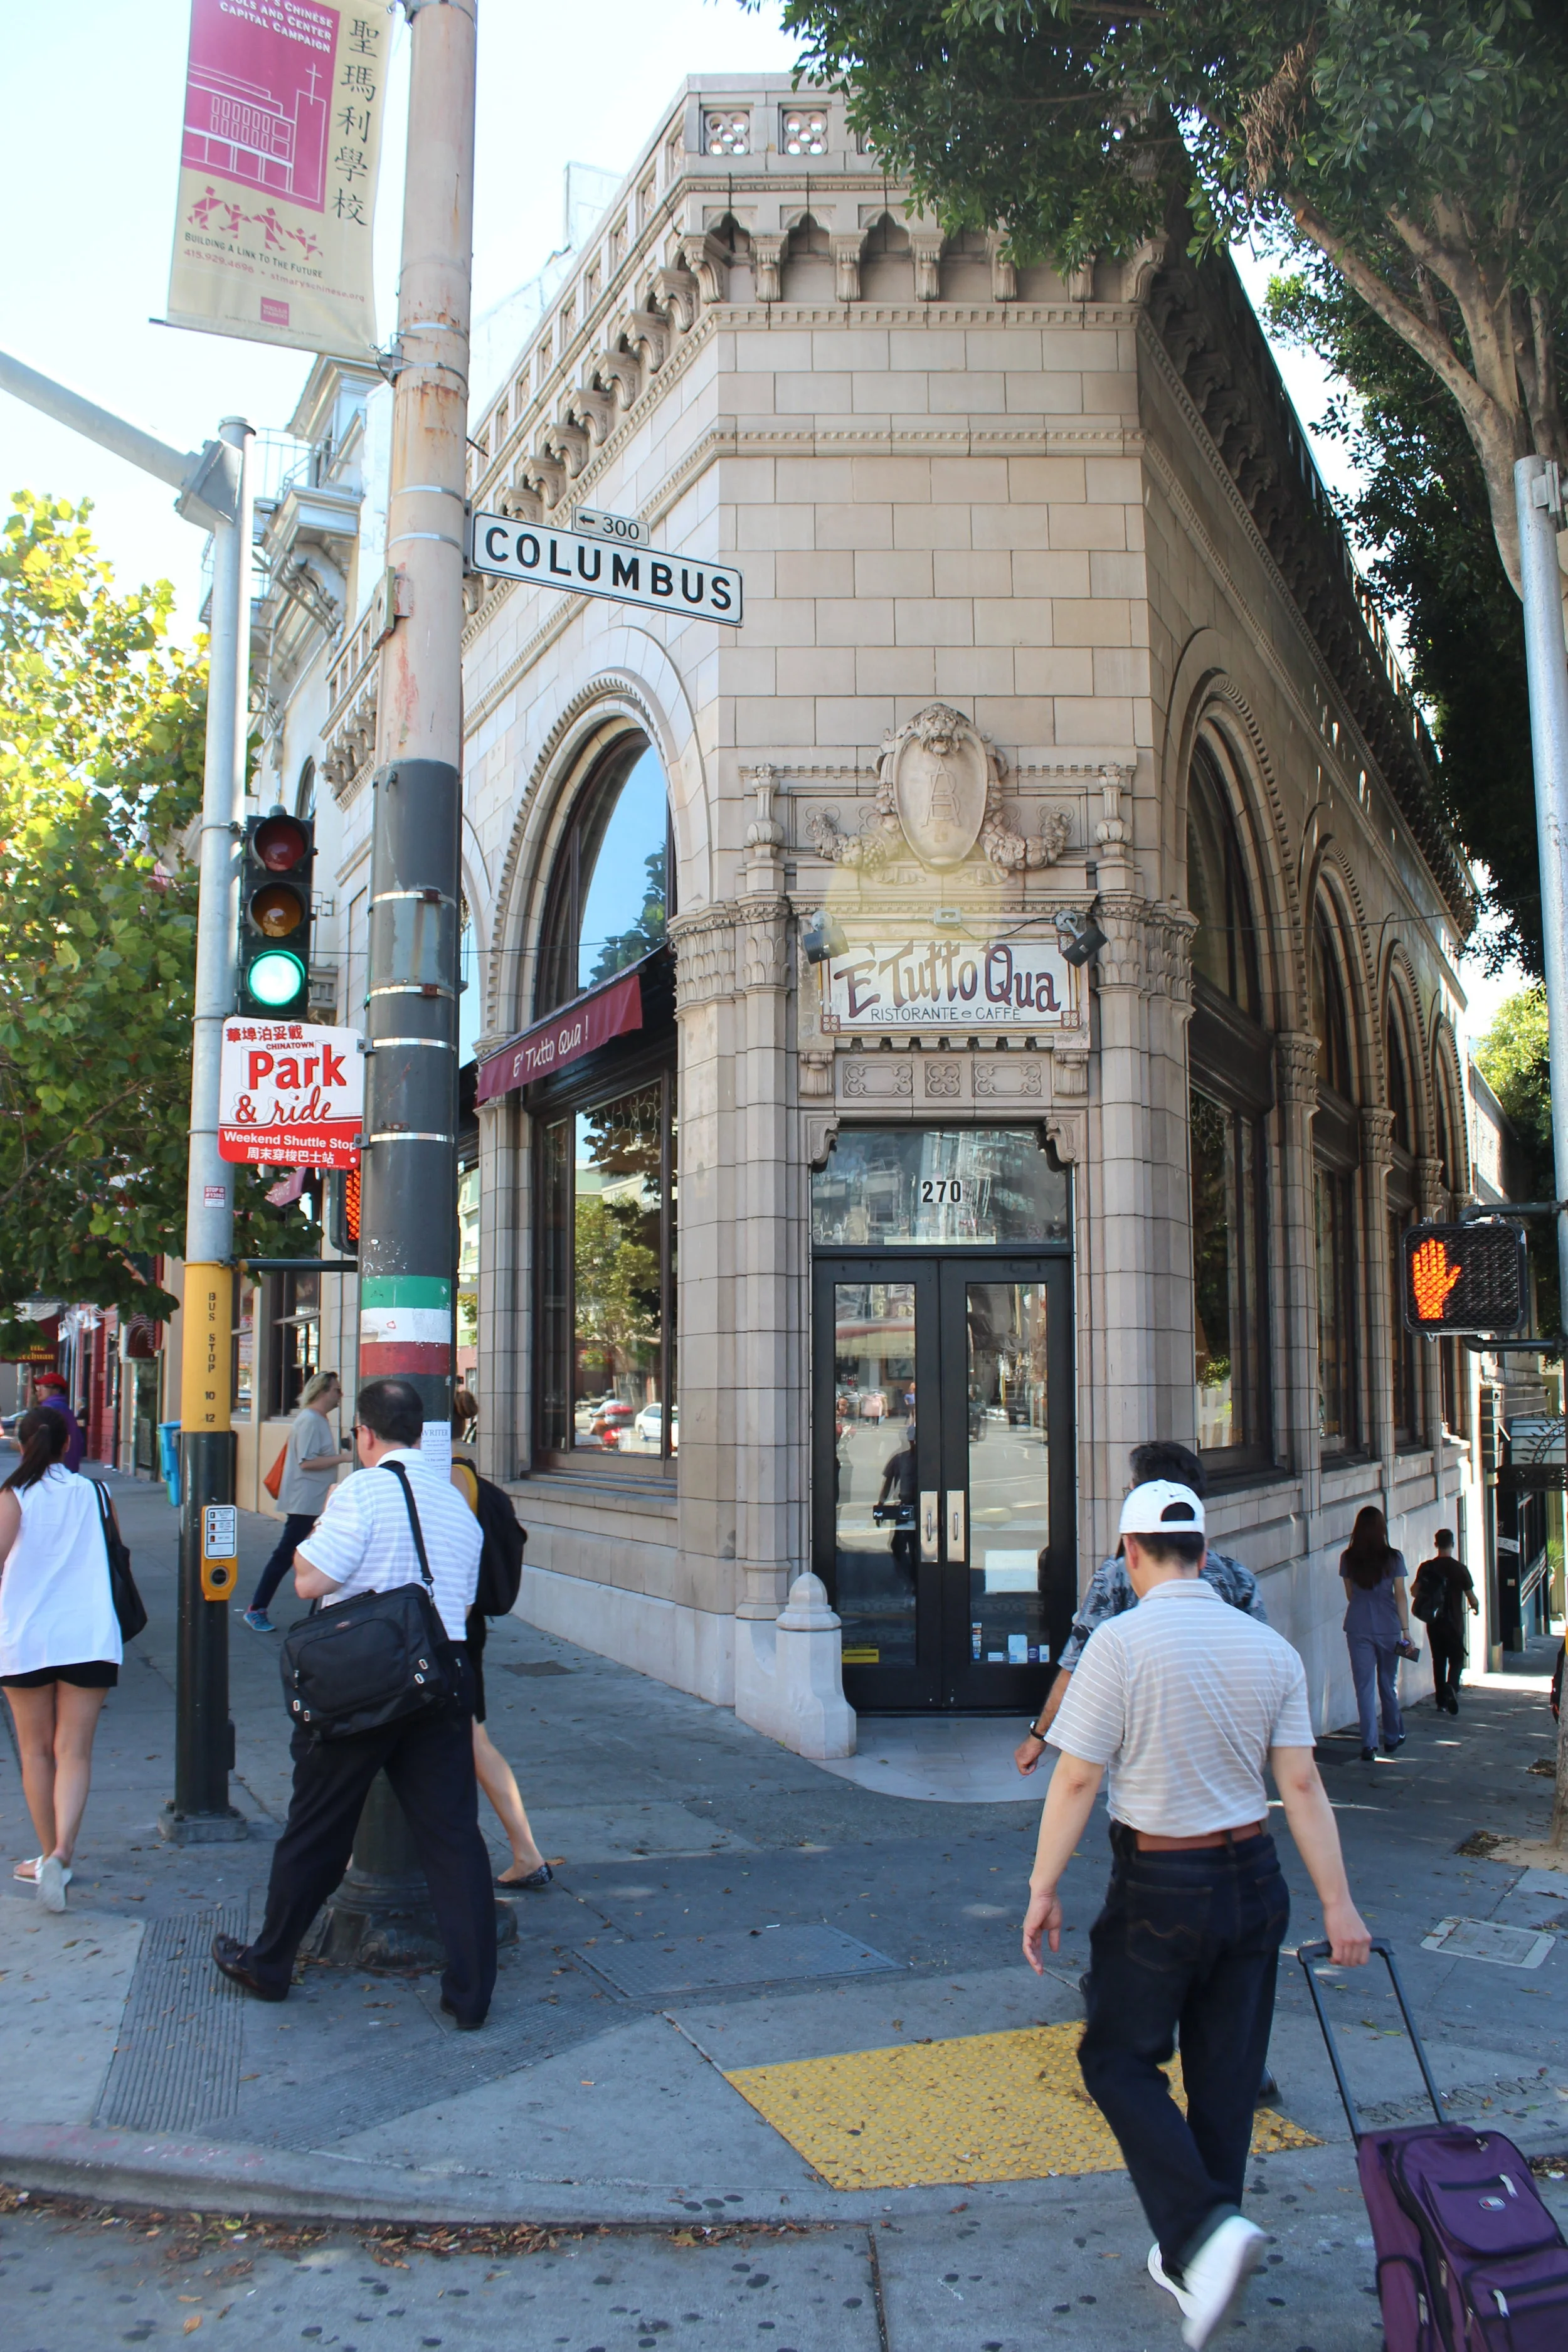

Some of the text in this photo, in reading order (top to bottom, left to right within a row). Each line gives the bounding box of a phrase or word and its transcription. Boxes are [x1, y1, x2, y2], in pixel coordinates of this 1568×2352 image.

[220, 2, 331, 54] CAPITAL CAMPAIGN
[260, 5, 283, 21] AND
[287, 16, 332, 41] CENTER
[284, 1, 334, 29] CHINESE
[329, 18, 380, 227] 聖瑪利學校
[228, 243, 235, 254] A
[259, 252, 270, 264] TO
[273, 257, 289, 271] THE
[290, 263, 323, 278] FUTURE
[603, 516, 640, 541] 300
[485, 526, 732, 611] COLUMBUS
[879, 940, 978, 1009] Tutto
[978, 940, 1062, 1013] Qua
[871, 1006, 1021, 1021] RISTORANTE e CAFFÈ
[266, 1041, 315, 1051] CHINATOWN
[525, 1037, 555, 1072] Tutto
[558, 1023, 582, 1055] Qua
[245, 1042, 347, 1090] Park
[235, 1085, 332, 1125] & ride
[223, 1131, 356, 1151] Weekend Shuttle Stop
[246, 1147, 335, 1165] 周末穿梭巴士站
[922, 1180, 962, 1204] 270
[208, 1292, 216, 1322] BUS
[204, 1391, 216, 1401] 10
[205, 1413, 215, 1423] 12
